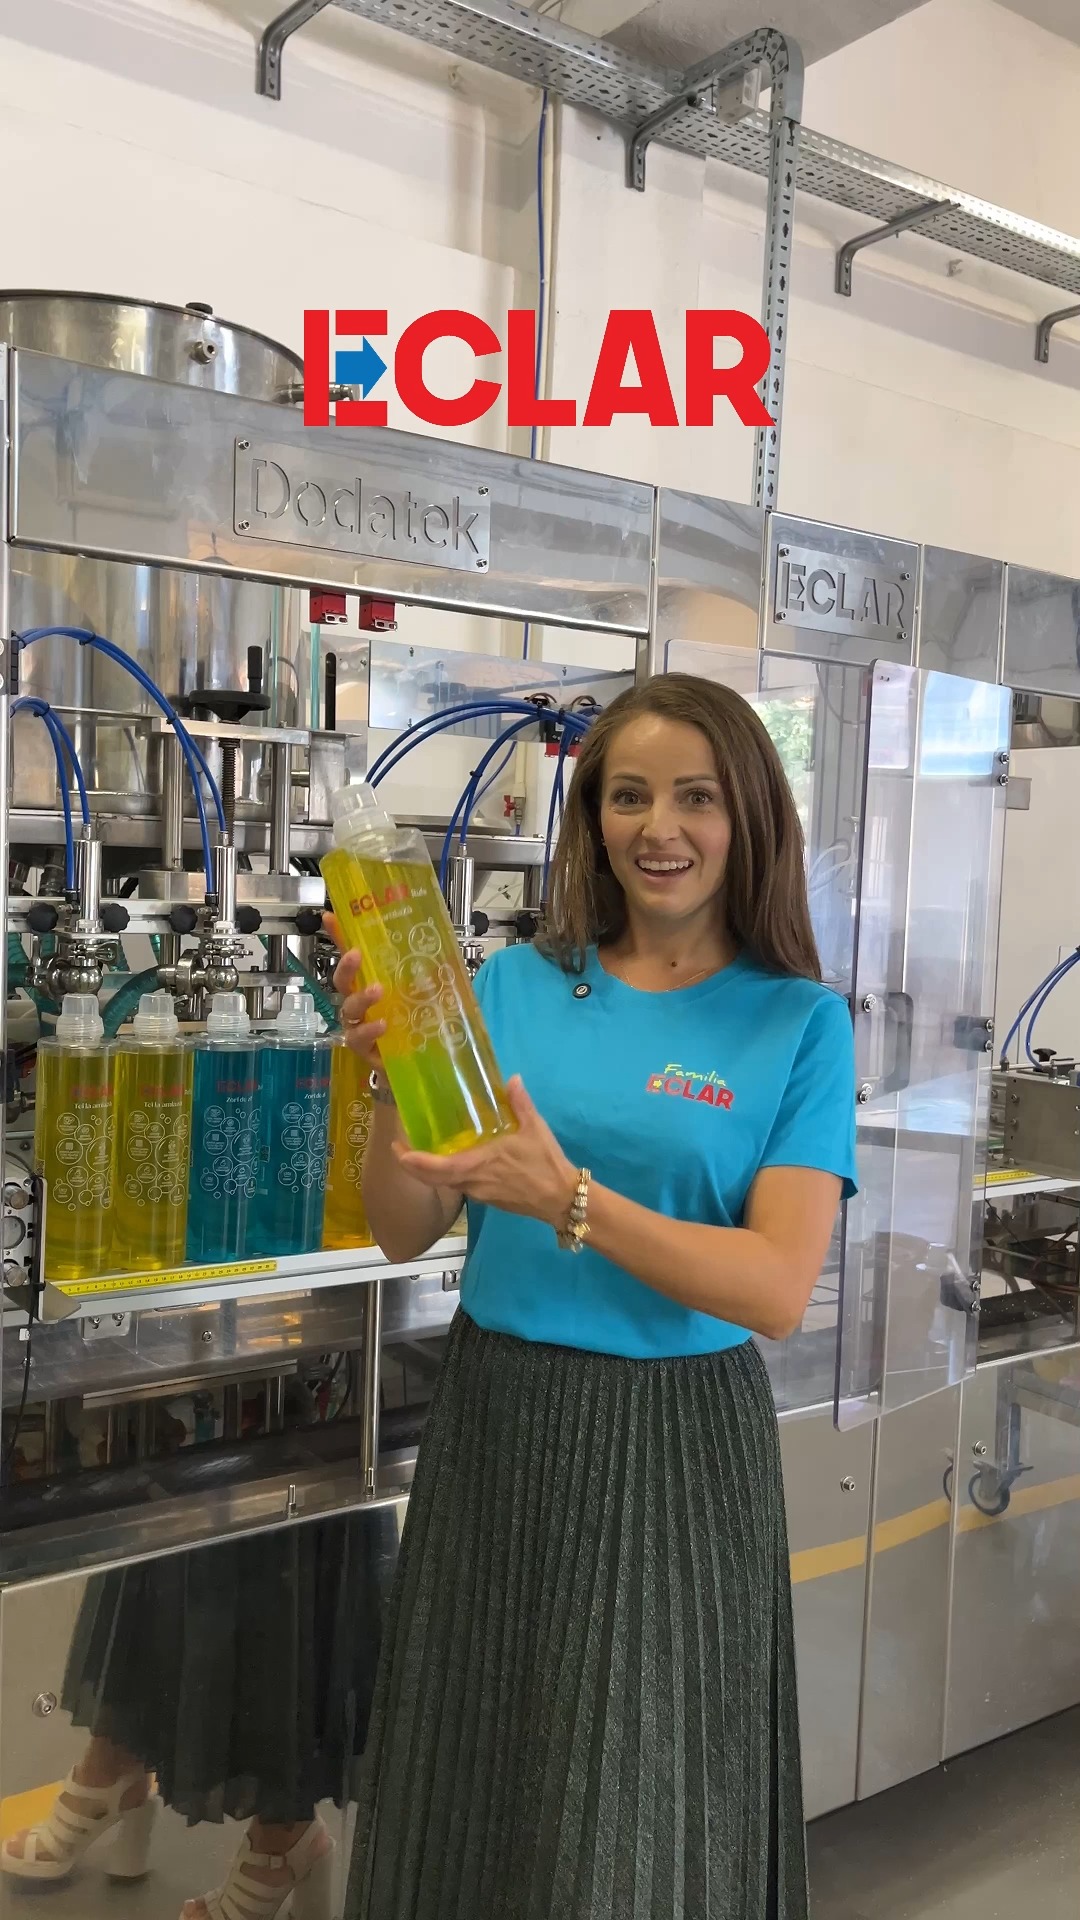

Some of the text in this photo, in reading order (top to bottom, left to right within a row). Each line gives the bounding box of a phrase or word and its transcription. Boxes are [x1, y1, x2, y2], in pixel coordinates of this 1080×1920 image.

[251, 458, 479, 554] Dodatek
[780, 561, 905, 628] ECLAR
[349, 883, 409, 917] ECLAR
[646, 1073, 735, 1111] ECLAR
[664, 1063, 727, 1086] Familia
